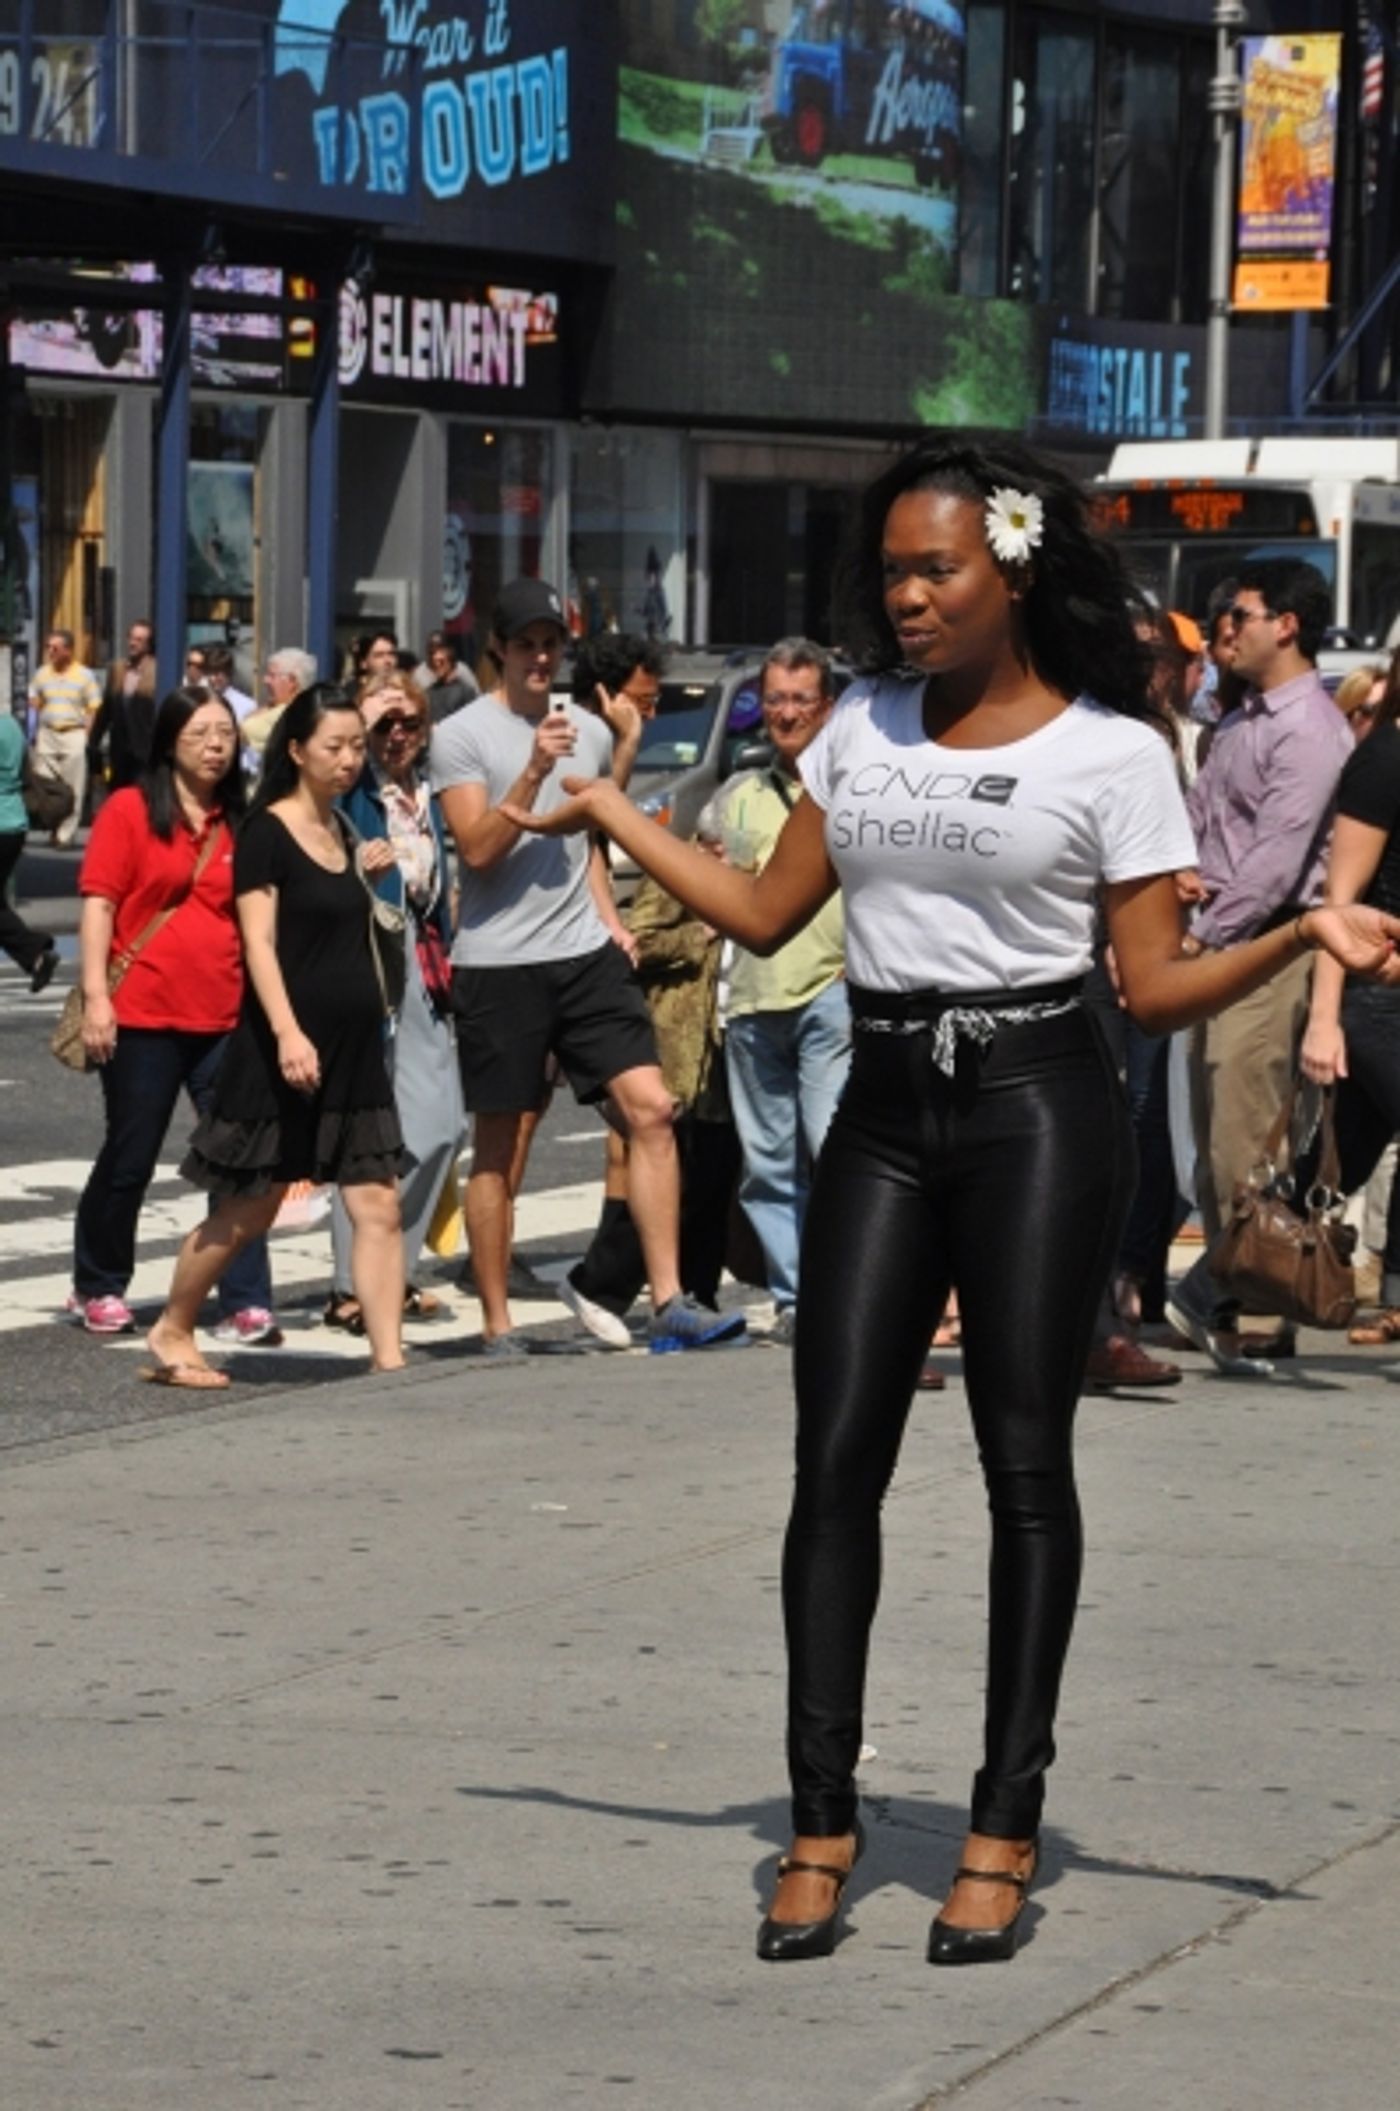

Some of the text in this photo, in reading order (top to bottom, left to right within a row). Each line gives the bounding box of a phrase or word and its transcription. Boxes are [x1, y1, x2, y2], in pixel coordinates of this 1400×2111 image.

[483, 0, 511, 55] it
[313, 47, 569, 199] PROUD!
[372, 292, 526, 388] ELEMENT
[833, 809, 1001, 858] Shellac
